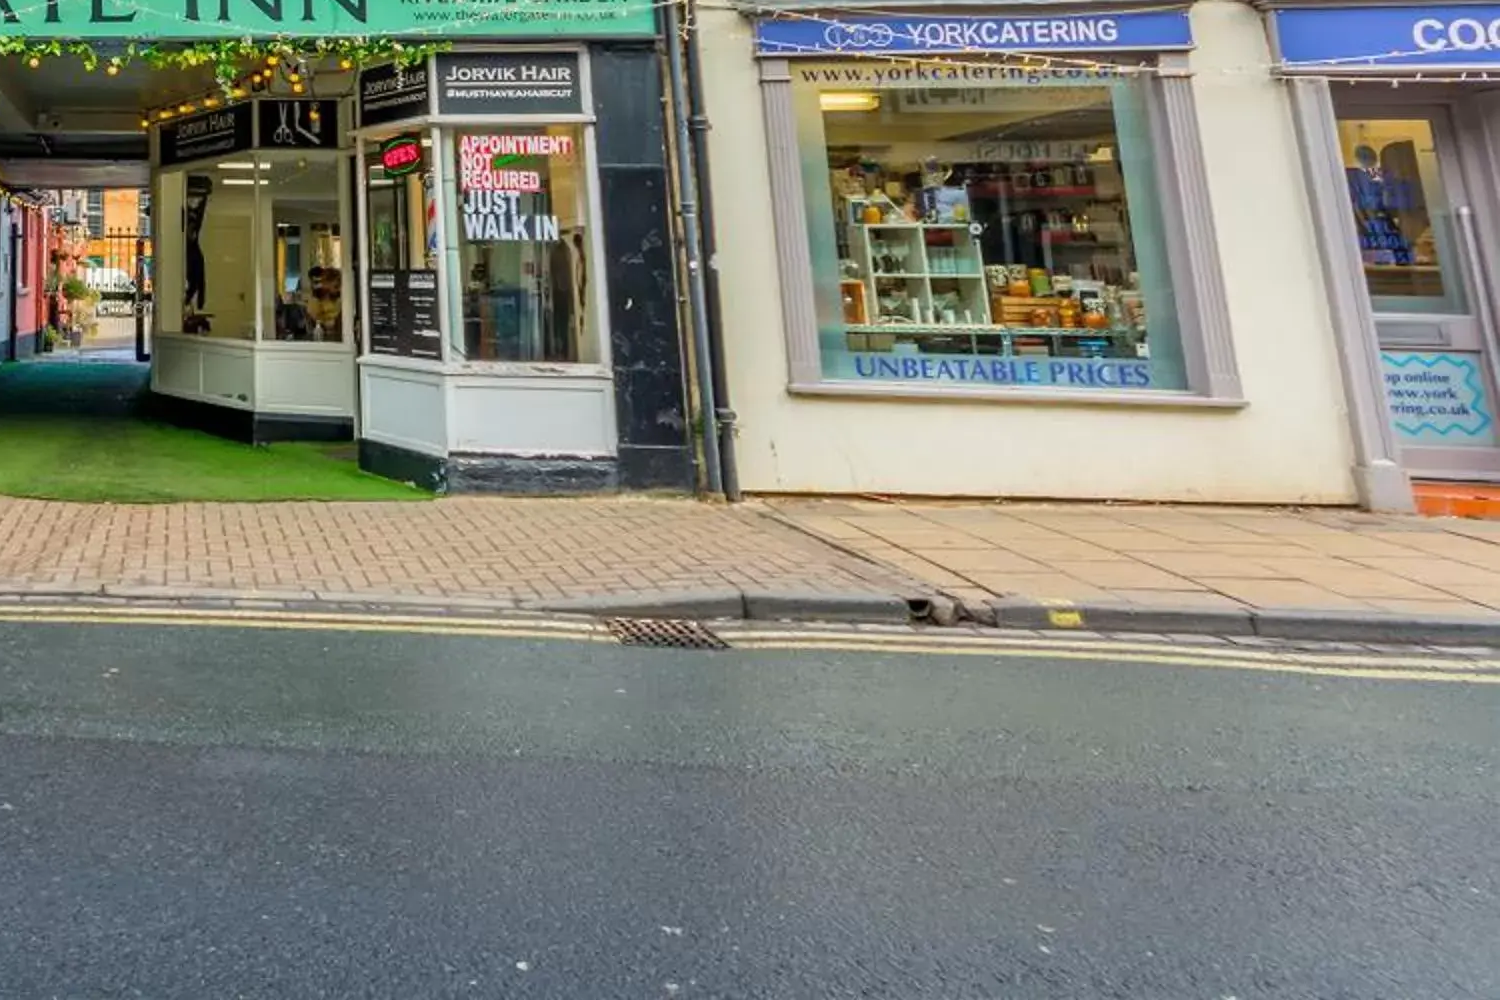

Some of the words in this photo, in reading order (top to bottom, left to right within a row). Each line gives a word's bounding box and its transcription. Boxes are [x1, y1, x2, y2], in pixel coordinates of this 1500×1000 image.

[907, 19, 1118, 45] YORKCATERING
[445, 65, 517, 81] JORVIK
[521, 65, 572, 81] HAIR
[461, 135, 570, 155] APPOINTMENT
[461, 154, 493, 172] NOT
[462, 170, 540, 190] REQUIRED
[463, 190, 521, 215] JUST
[463, 214, 529, 241] WALK
[535, 215, 559, 241] IN
[855, 355, 1041, 383] UNBEATABLE
[1051, 360, 1151, 387] PRICES
